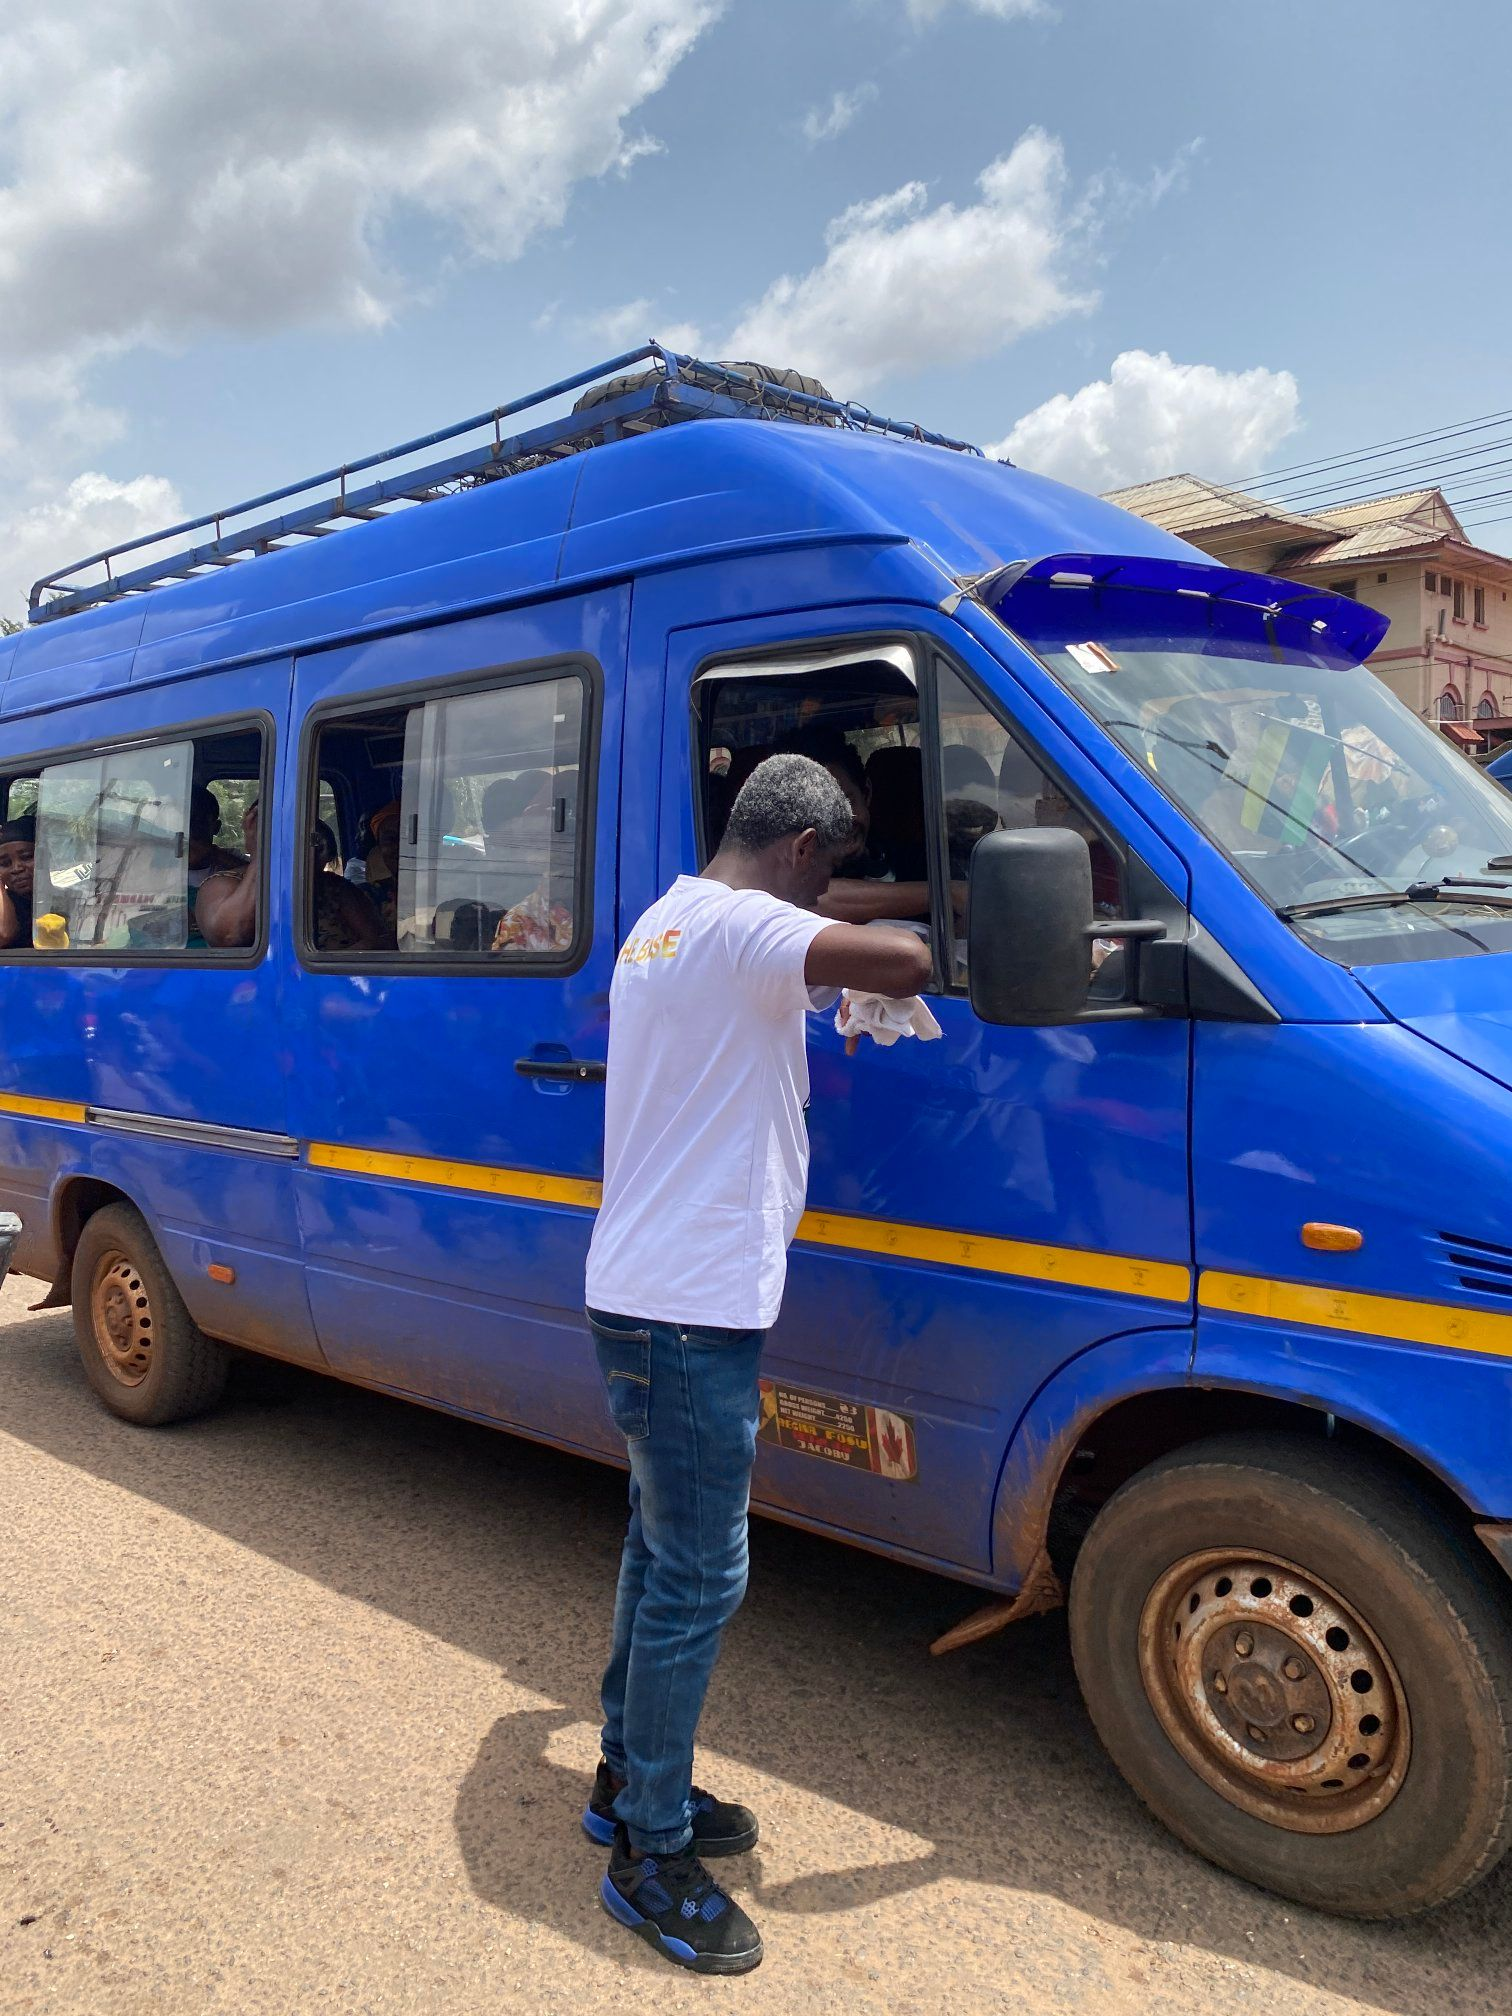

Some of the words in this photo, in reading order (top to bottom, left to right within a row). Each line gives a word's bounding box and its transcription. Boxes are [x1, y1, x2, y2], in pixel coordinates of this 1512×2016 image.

[798, 1396, 826, 1408] PERSONS
[792, 1410, 816, 1421] WEIGHT
[800, 1404, 825, 1416] WEIGHT
